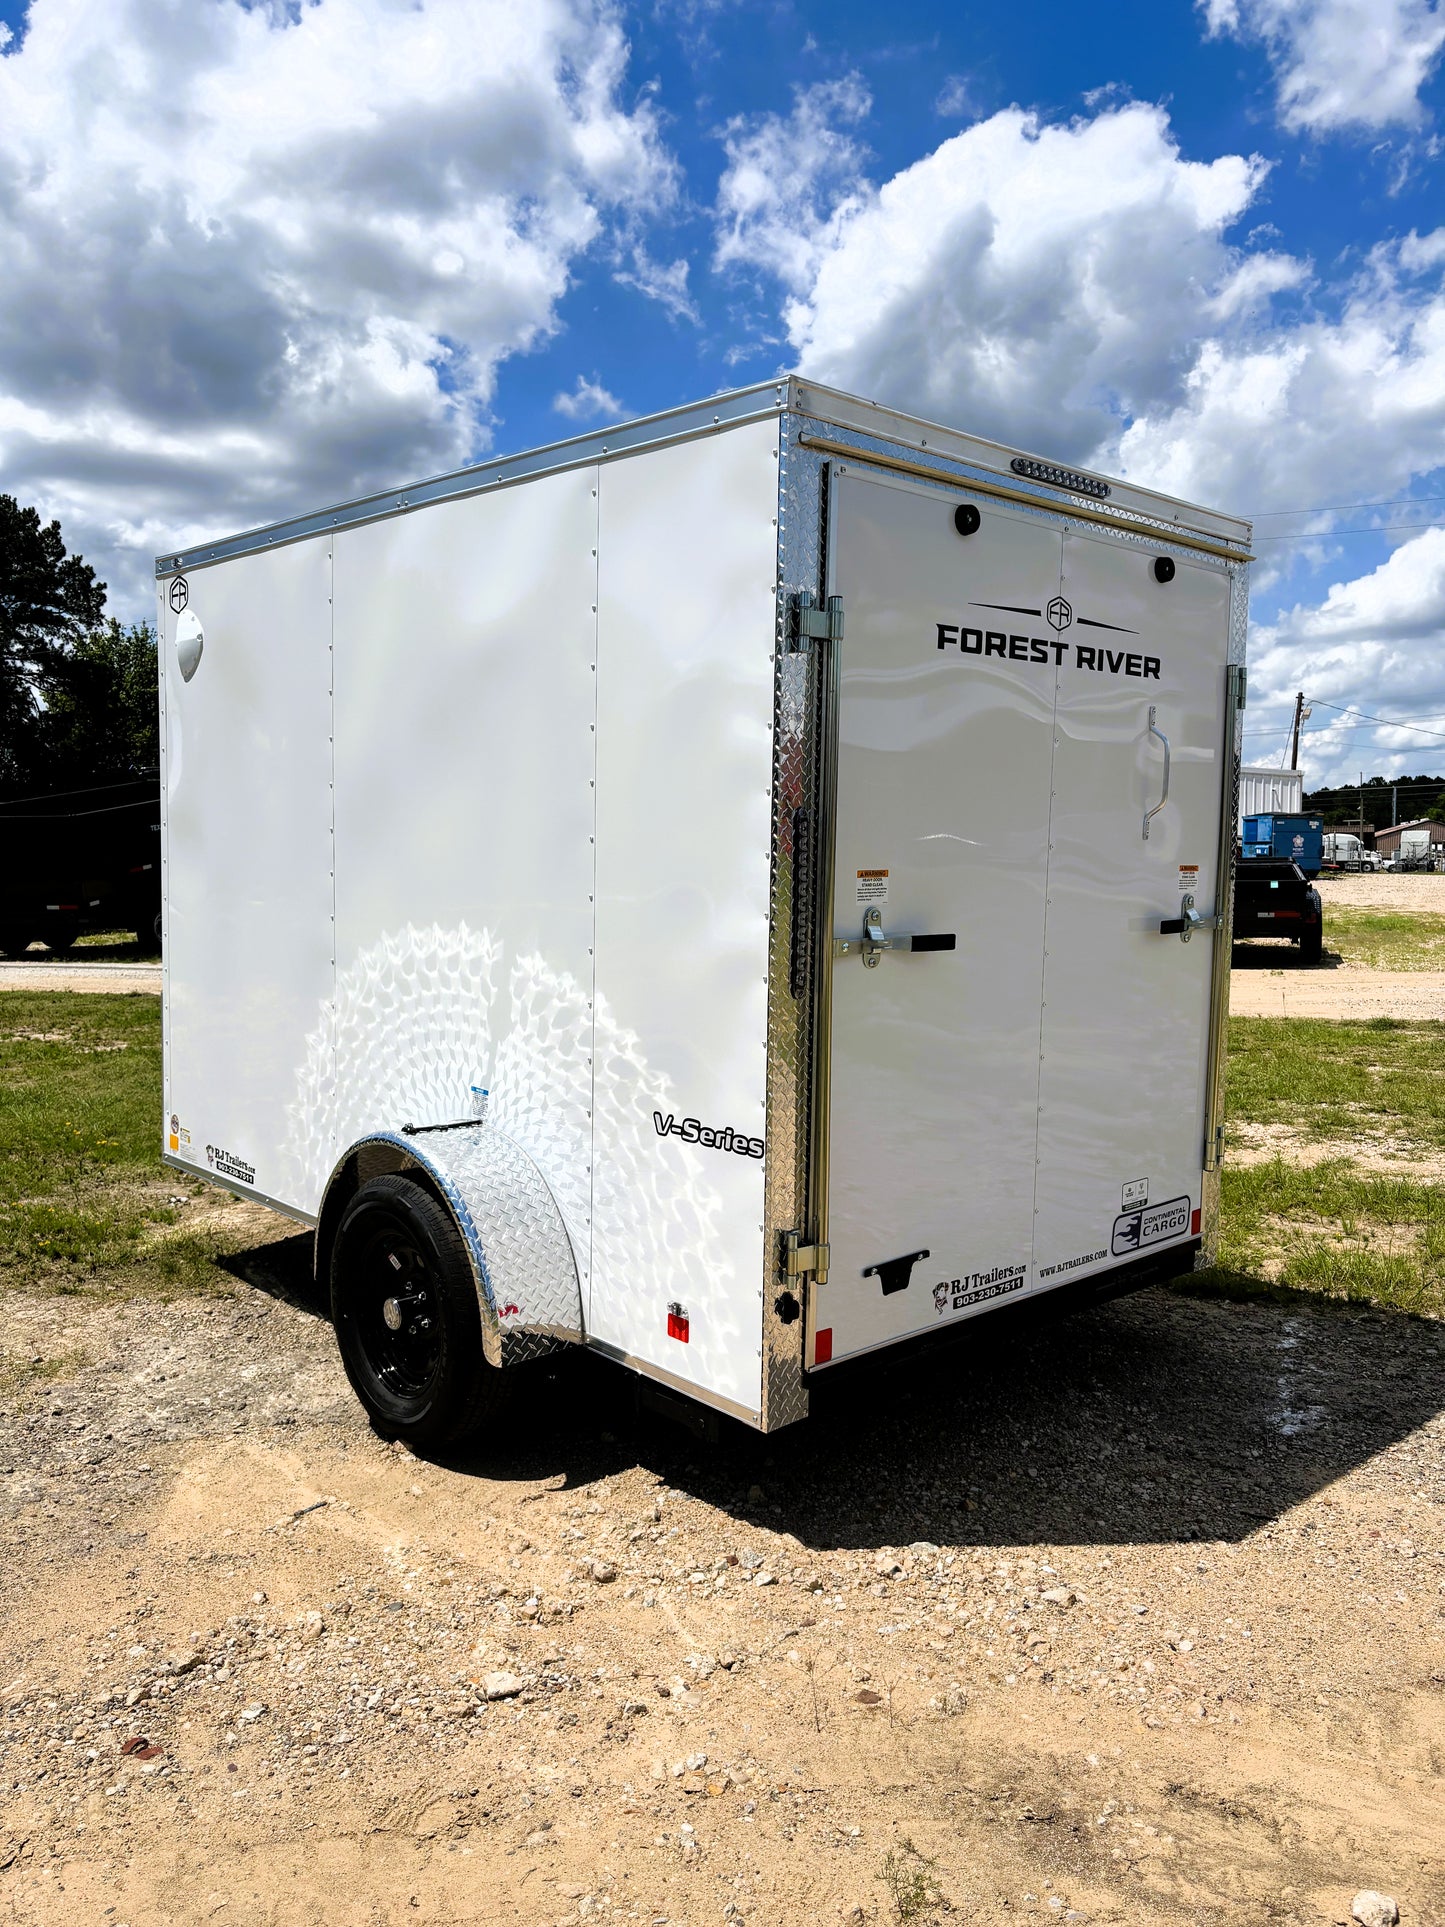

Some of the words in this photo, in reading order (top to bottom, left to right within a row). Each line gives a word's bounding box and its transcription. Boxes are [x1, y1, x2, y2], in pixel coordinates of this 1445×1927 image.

[936, 623, 1069, 665] FOREST
[1076, 645, 1161, 680] RIVER
[653, 1111, 765, 1159] V-Series
[214, 1148, 225, 1161] RJ
[216, 1162, 254, 1184] 903-230-7511
[1142, 1214, 1186, 1237] CARGO
[1143, 1206, 1186, 1225] CONTINENTAL
[1039, 1249, 1108, 1278] WWW.RJTRAILERS.COM
[950, 1275, 970, 1295] RJ
[955, 1278, 1023, 1308] 903-230-7511
